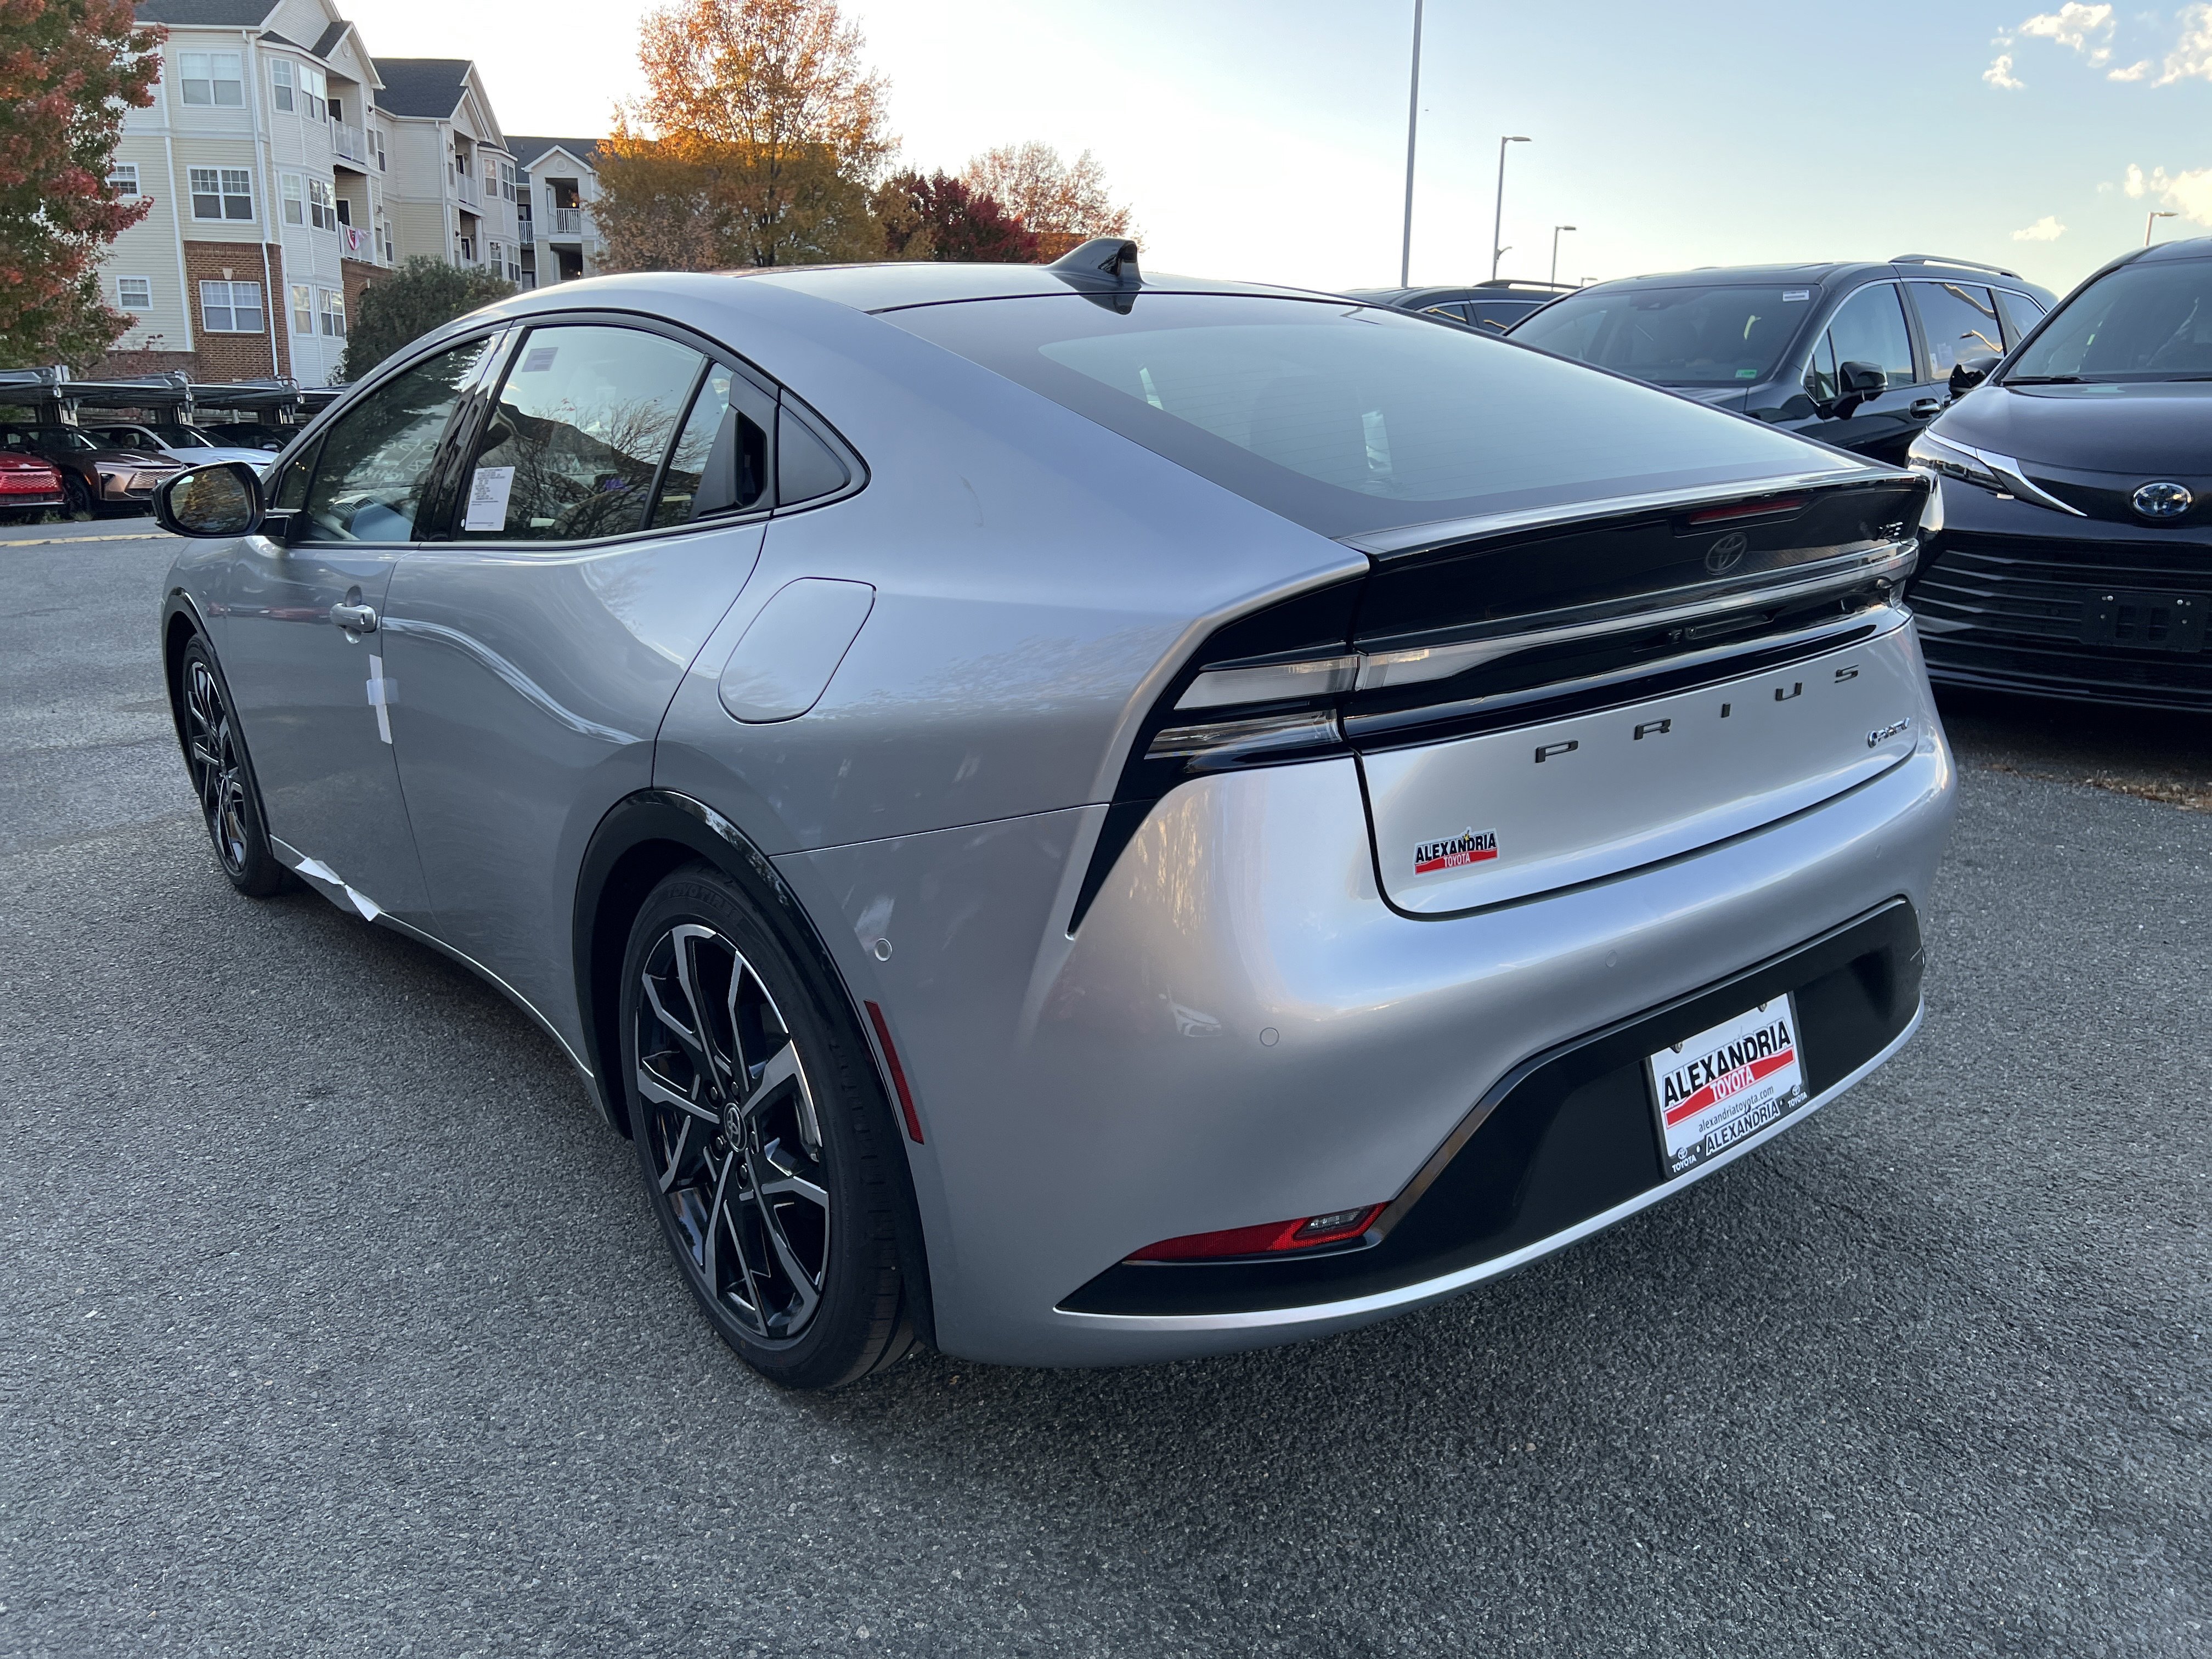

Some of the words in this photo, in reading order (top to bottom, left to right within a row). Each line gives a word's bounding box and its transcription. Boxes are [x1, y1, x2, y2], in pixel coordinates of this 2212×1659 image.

[1536, 664, 1859, 763] PRIUS
[1415, 833, 1497, 863] ALEXANDRIA
[1443, 852, 1471, 867] TOYOTA
[1664, 1021, 1791, 1108] ALEXANDRIA
[1710, 1066, 1754, 1101] TOYOTA
[1787, 1091, 1808, 1108] TOYOTA
[1699, 1085, 1774, 1132] alexandriatoyota.com
[1706, 1100, 1779, 1155] ALEXANDRIA
[1672, 1154, 1697, 1173] TOYOTA
